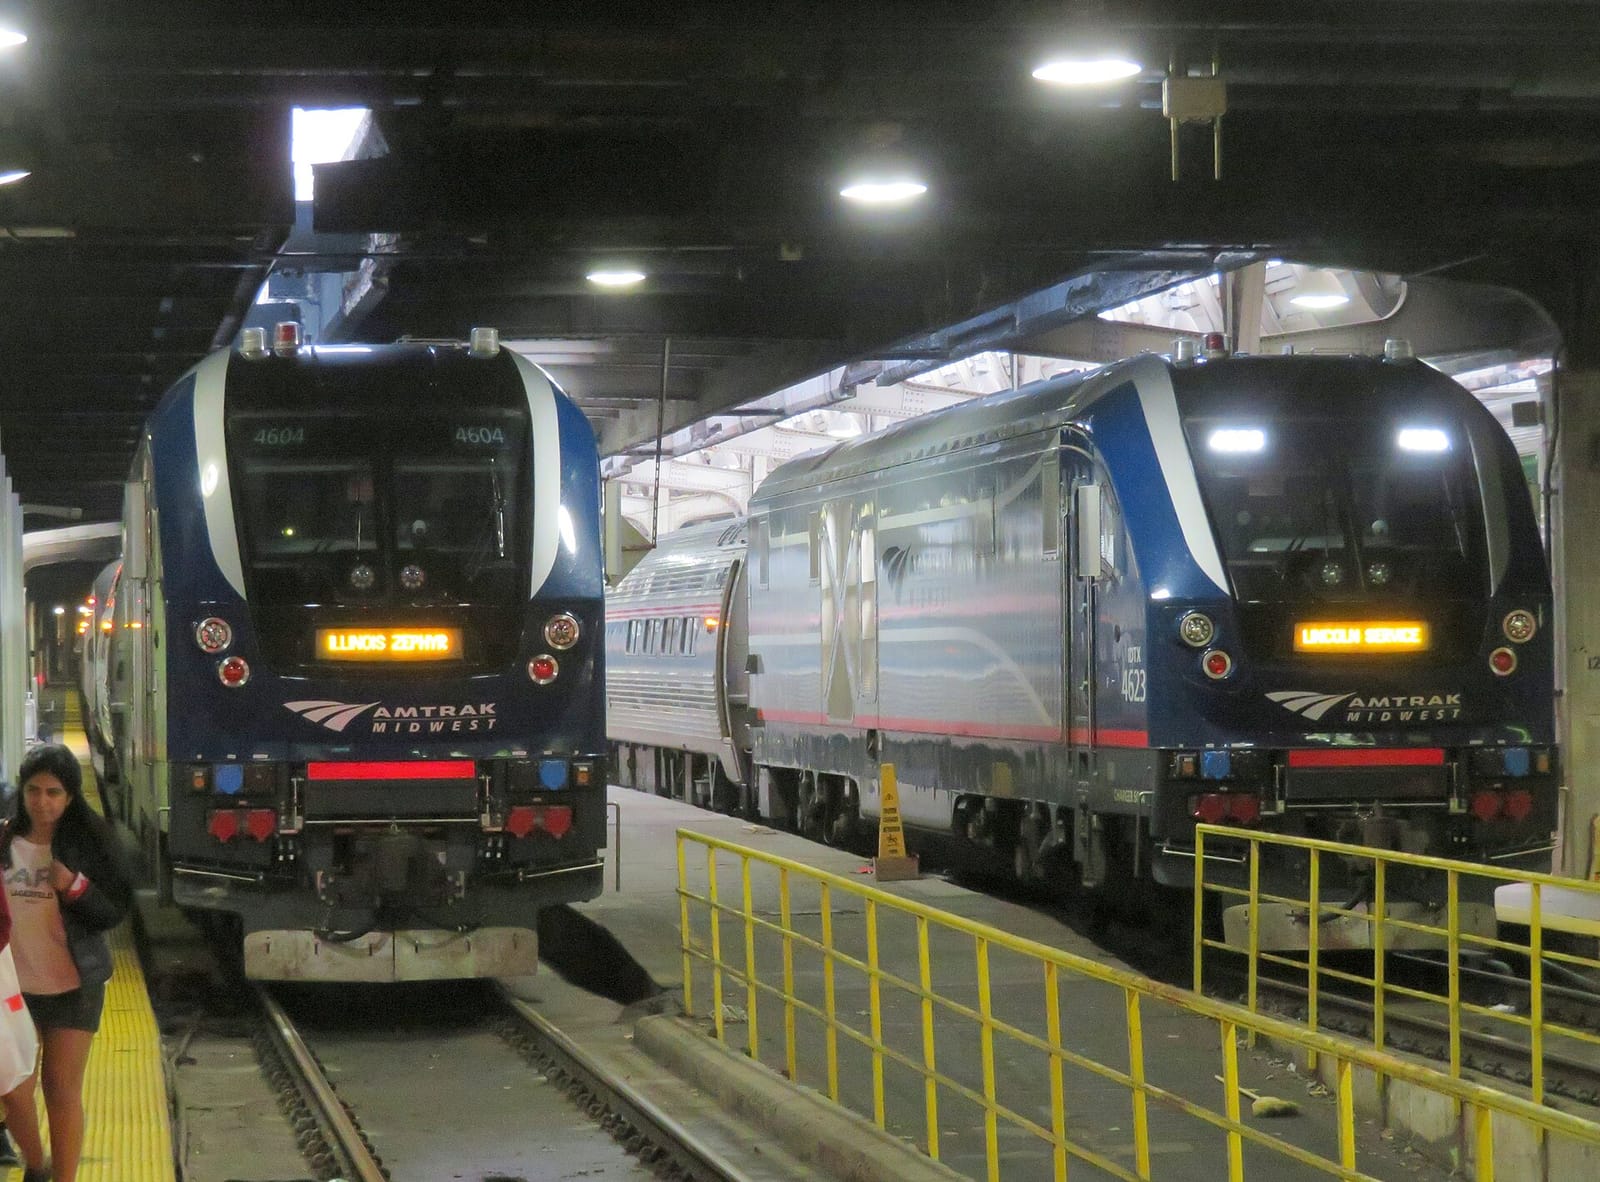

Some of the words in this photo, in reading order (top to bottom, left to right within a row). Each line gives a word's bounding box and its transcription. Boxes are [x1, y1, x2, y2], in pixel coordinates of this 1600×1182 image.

[254, 427, 304, 444] 4604
[456, 427, 505, 444] 4604
[327, 633, 387, 651] ILLINOIS
[390, 633, 449, 651] ZEPHYR
[1302, 628, 1361, 645] LINCOLN
[1364, 627, 1421, 644] SERVICE
[1121, 669, 1146, 702] 4623
[1348, 694, 1460, 708] AMTRAK
[373, 703, 496, 718] AMTRAK
[1347, 709, 1460, 722] MIDWEST
[372, 719, 497, 733] MIDWEST
